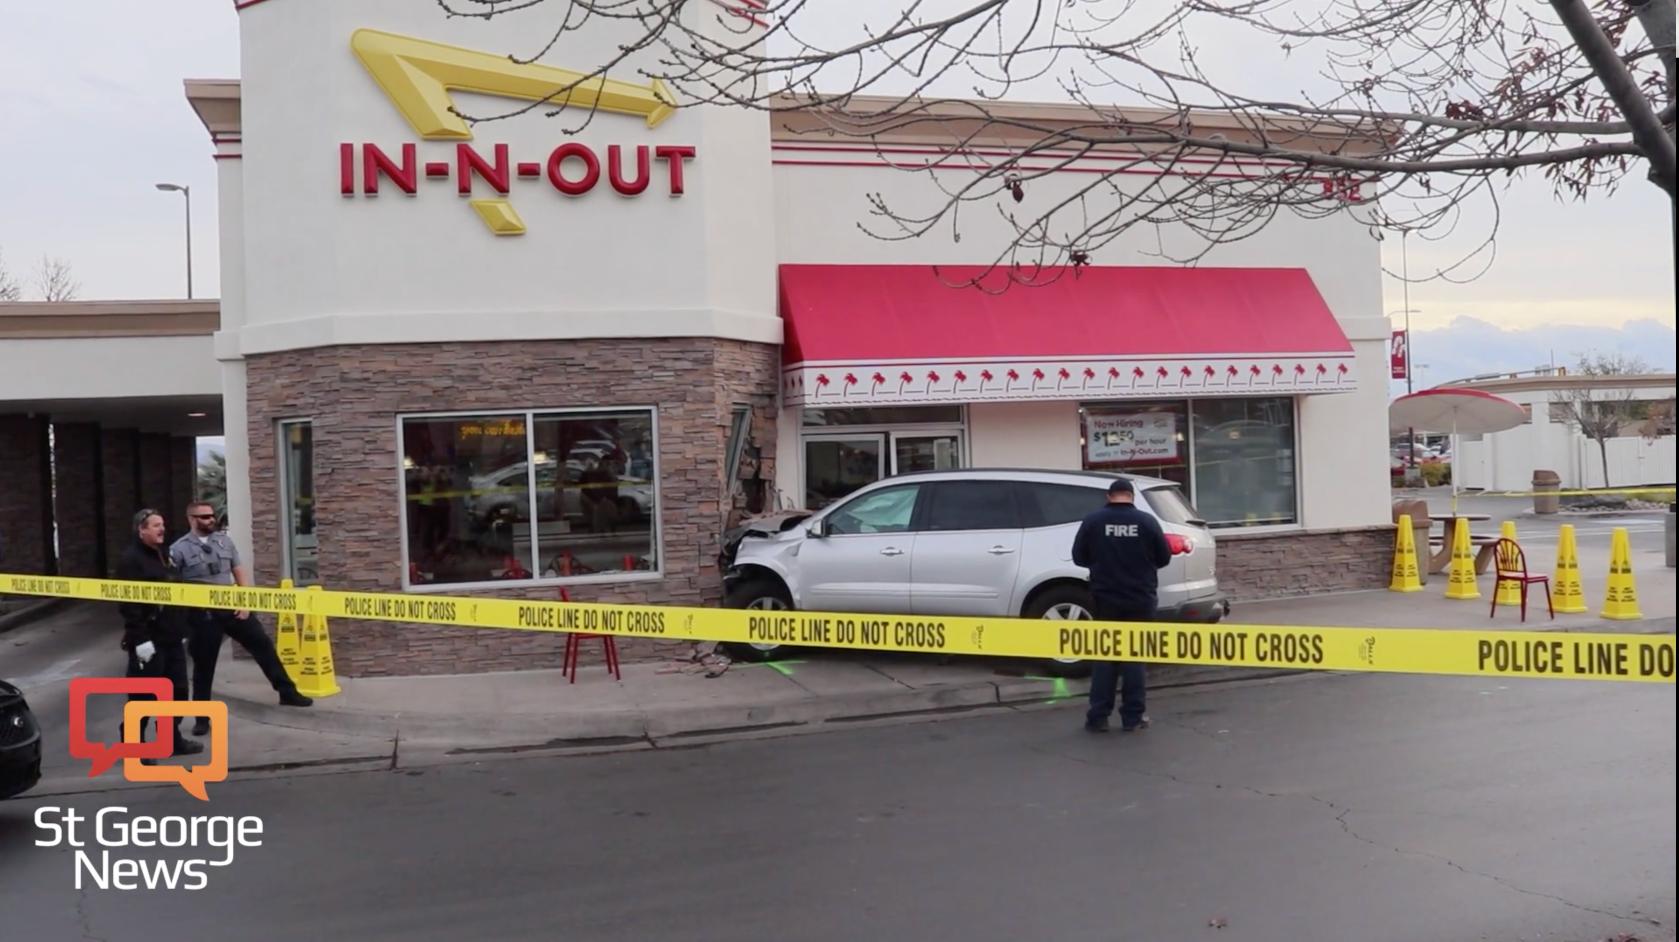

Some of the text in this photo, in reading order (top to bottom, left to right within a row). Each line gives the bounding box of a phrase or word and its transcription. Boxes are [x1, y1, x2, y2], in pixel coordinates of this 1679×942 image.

[340, 142, 696, 198] IN-N-OUT
[1094, 419, 1114, 429] Now
[1116, 418, 1143, 428] Hiring
[1105, 524, 1139, 537] FIRE
[100, 583, 172, 602] POLICE LINE DO NOT CROSS
[209, 589, 231, 606] POLICE
[233, 591, 247, 608] LINE
[248, 591, 258, 608] DO
[259, 592, 272, 609] NOT
[273, 593, 297, 610] CROSS
[344, 597, 372, 616] POLICE
[374, 598, 392, 617] LINE
[394, 600, 406, 618] DO
[408, 600, 425, 619] NOT
[426, 601, 457, 621] CROSS
[518, 606, 554, 628] POLICE
[556, 608, 580, 629] LINE
[583, 610, 598, 631] DO
[601, 610, 624, 632] NOT
[626, 611, 665, 634] CROSS
[749, 617, 796, 641] POLICE
[800, 618, 831, 643] LINE
[836, 619, 856, 644] DO
[860, 620, 890, 646] NOT
[893, 621, 946, 649] CROSS
[1059, 628, 1122, 657] POLICE
[1128, 630, 1170, 658] LINE
[1176, 631, 1203, 660] DO
[1209, 632, 1249, 661] NOT
[1255, 633, 1324, 664] CROSS
[1478, 639, 1675, 678] POLICE LINE DO
